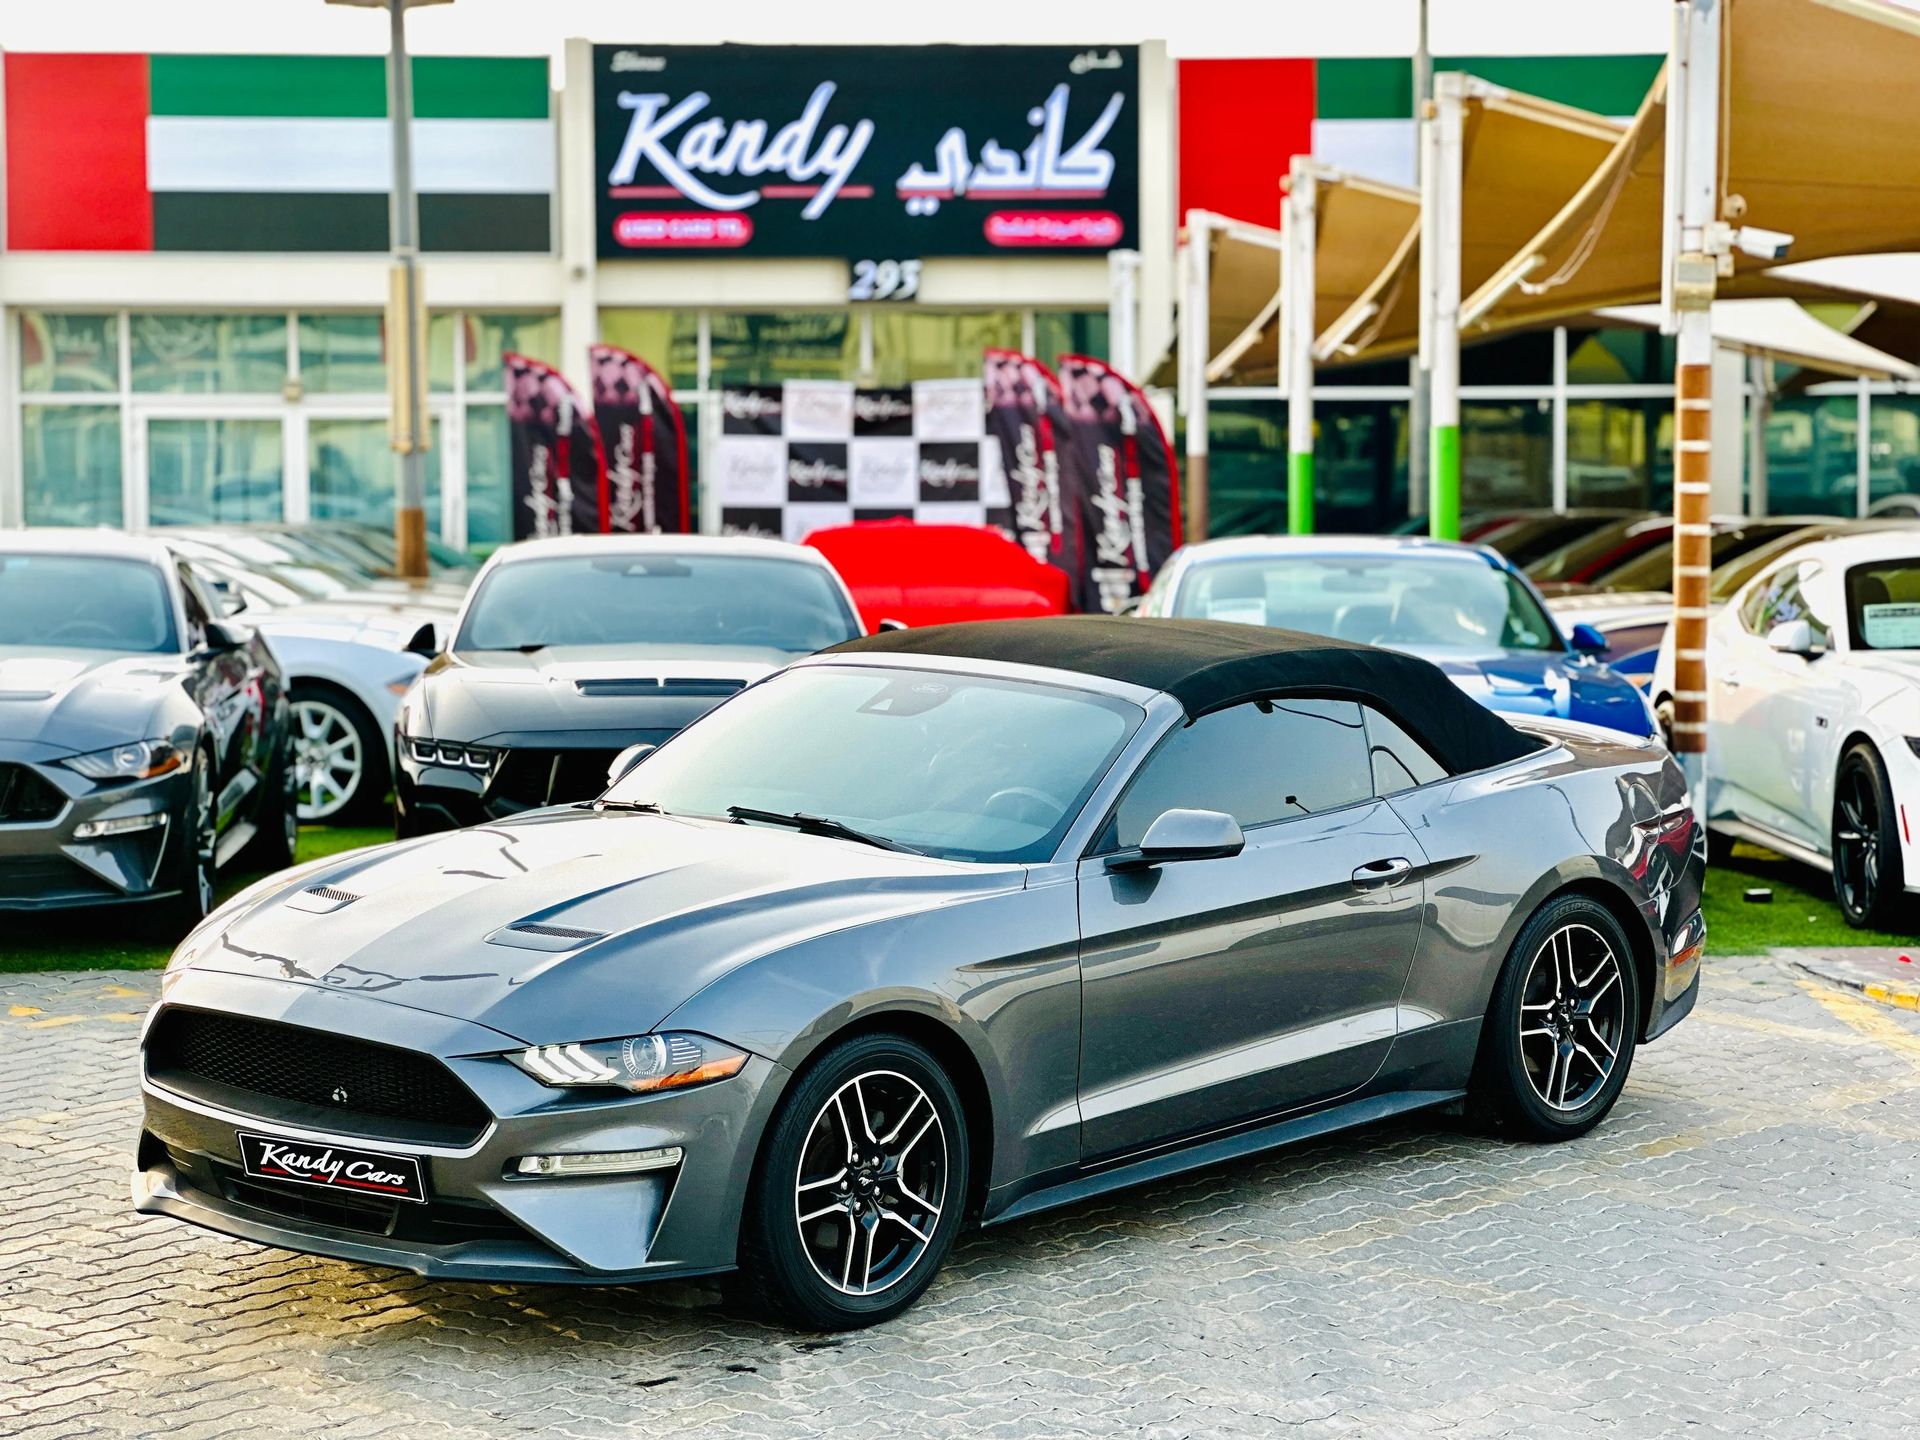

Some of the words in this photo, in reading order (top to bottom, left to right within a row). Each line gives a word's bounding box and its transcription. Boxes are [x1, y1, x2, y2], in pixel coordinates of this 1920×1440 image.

[609, 81, 875, 220] Kandy
[896, 83, 1125, 216] كاندي
[848, 259, 923, 300] 295
[259, 1141, 344, 1184] Kandy
[345, 1161, 406, 1186] Cars
